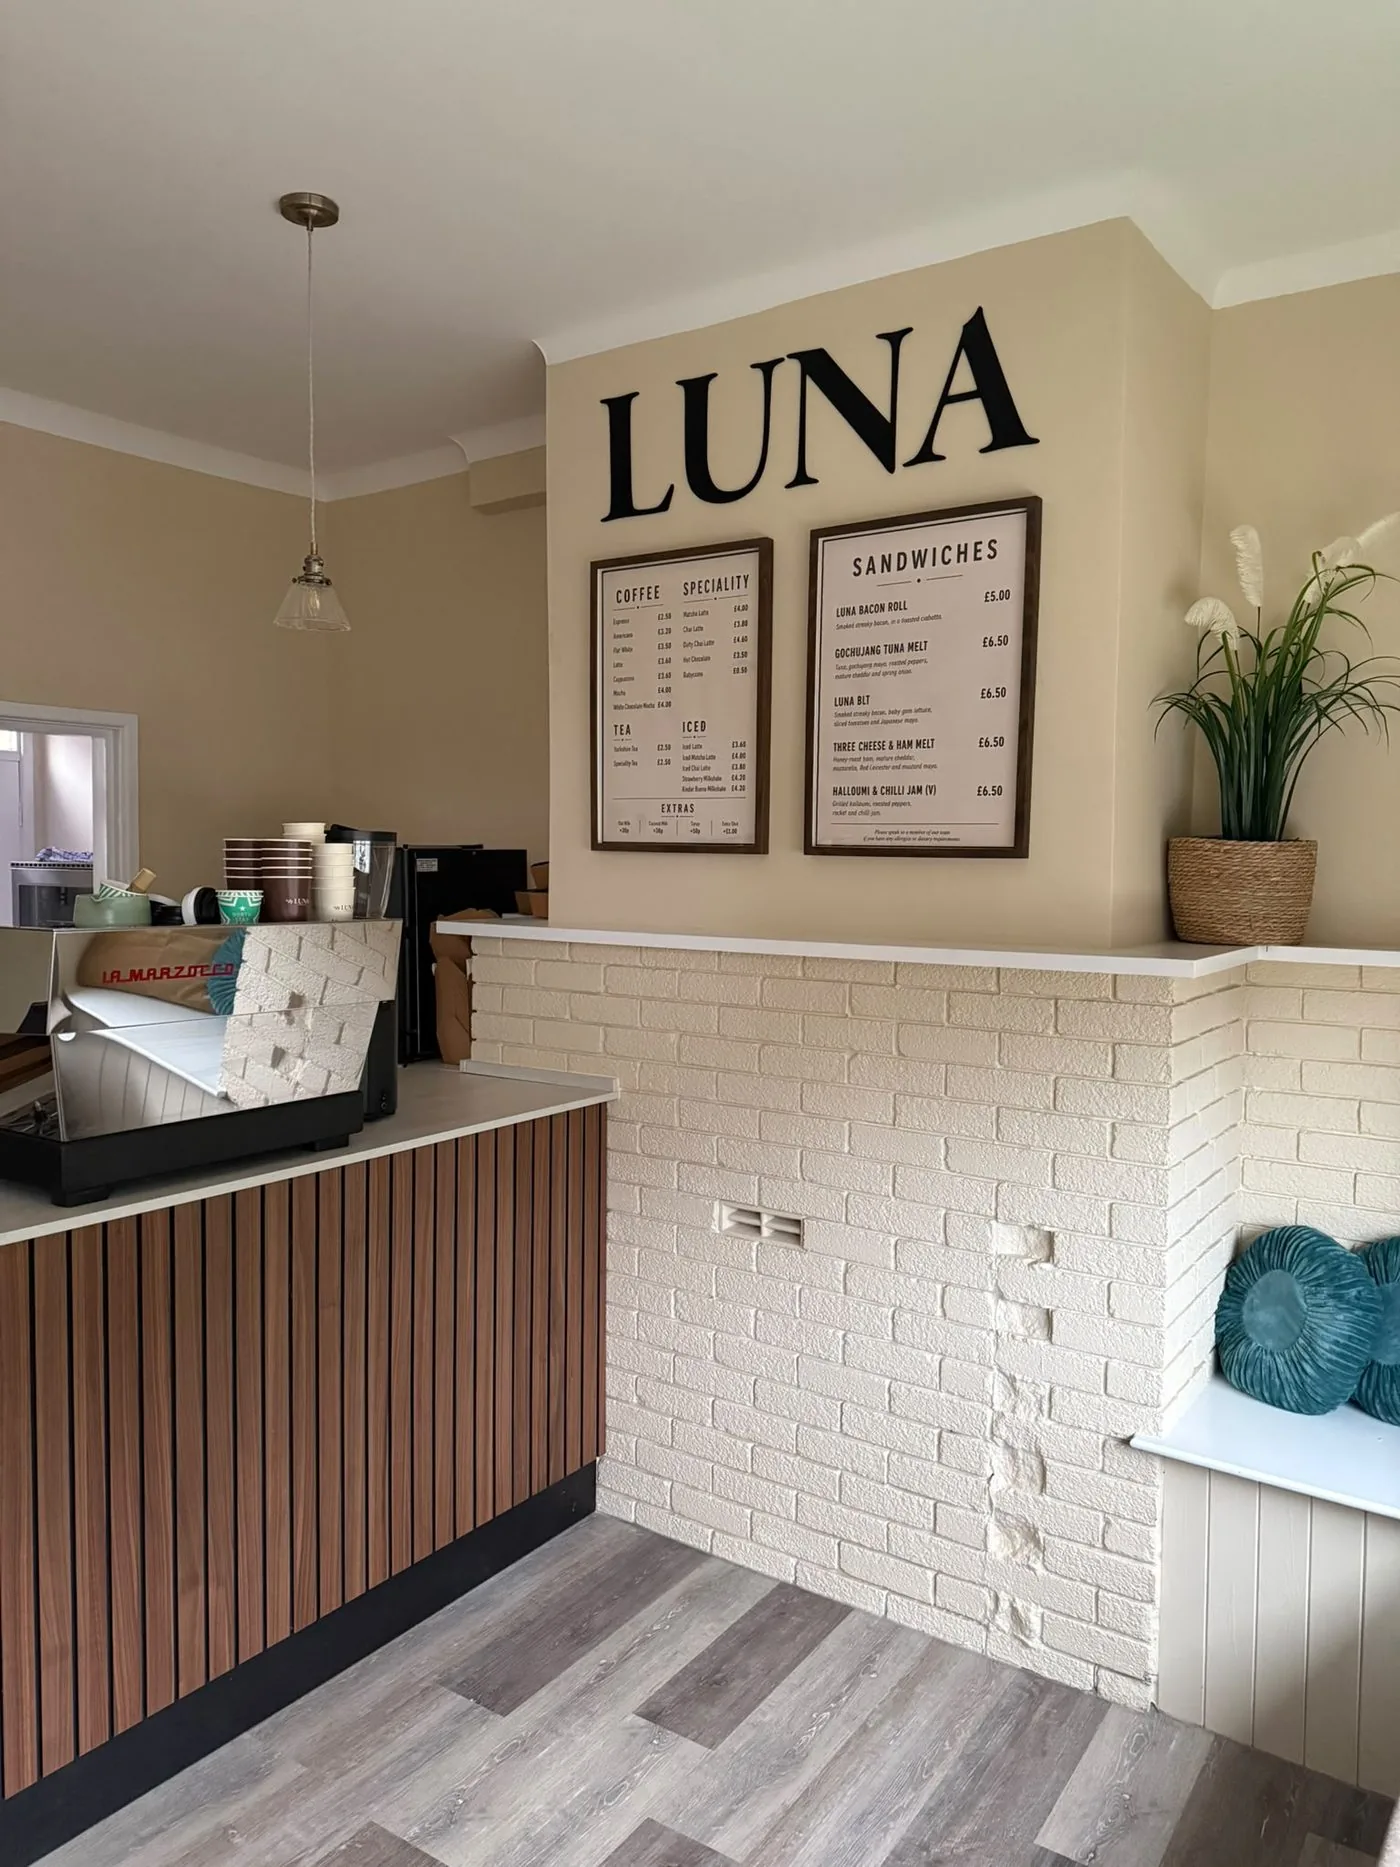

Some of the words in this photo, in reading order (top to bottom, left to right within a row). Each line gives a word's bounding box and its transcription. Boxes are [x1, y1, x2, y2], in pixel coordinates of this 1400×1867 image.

[600, 305, 1040, 523] LUNA
[852, 538, 998, 577] SANDWICHES
[683, 574, 749, 596] SPECIALITY
[616, 585, 660, 604] COFFEE
[733, 604, 748, 613] £4.00
[836, 606, 857, 618] LUNA
[858, 602, 885, 615] BACON
[888, 600, 908, 612] ROLL
[984, 588, 1011, 603] £5.00
[835, 645, 881, 659] GOCHUJANG
[884, 643, 904, 655] TUNA
[908, 640, 928, 652] MELT
[982, 634, 1009, 648] £6.50
[657, 686, 672, 694] £4.00
[834, 697, 854, 707] LUNA
[857, 695, 870, 706] BLT
[980, 687, 1007, 699] £6.50
[613, 724, 631, 736] TEA
[682, 720, 707, 733] ICED
[657, 743, 671, 751] £2.50
[833, 741, 855, 752] THREE
[858, 740, 886, 751] CHEESE
[888, 740, 894, 750] &
[896, 739, 913, 750] HAM
[915, 738, 935, 749] MELT
[978, 736, 1005, 748] £6.50
[657, 758, 671, 766] £2.50
[732, 752, 746, 760] £4.00
[731, 773, 746, 781] £4.20
[731, 784, 746, 792] £4.20
[832, 786, 870, 796] HALLOUMI
[872, 786, 878, 796] &
[880, 785, 905, 796] CHILLI
[907, 785, 923, 796] JAM
[925, 784, 937, 797] (V)
[976, 785, 1003, 797] £6.50
[661, 803, 695, 813] EXTRAS
[102, 970, 121, 984] LA
[129, 963, 235, 982] MARZOCCO
